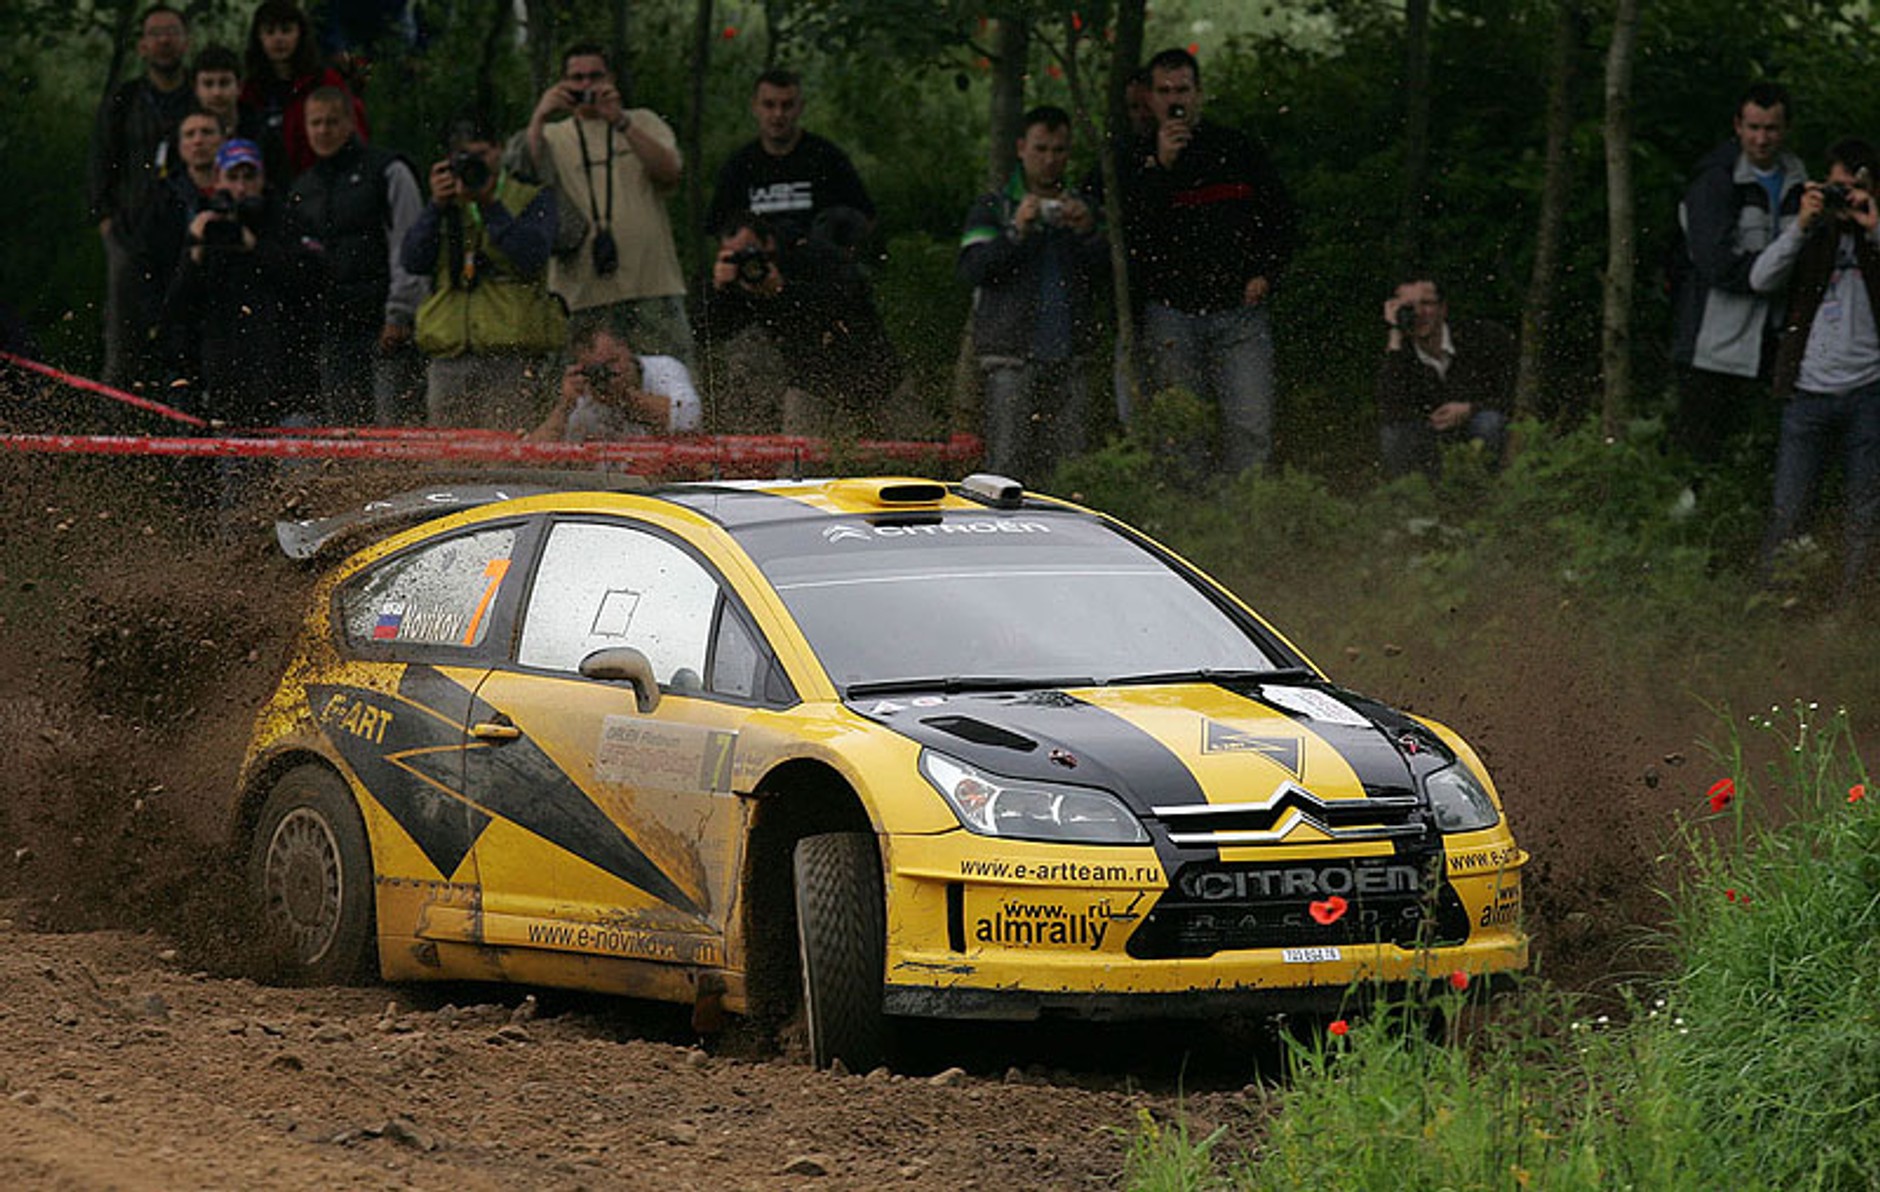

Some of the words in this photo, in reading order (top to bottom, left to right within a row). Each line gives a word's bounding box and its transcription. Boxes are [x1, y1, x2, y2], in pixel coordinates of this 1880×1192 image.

[710, 733, 734, 790] 7
[960, 860, 1158, 882] www.e-artteam.ru
[976, 912, 1107, 950] almrally
